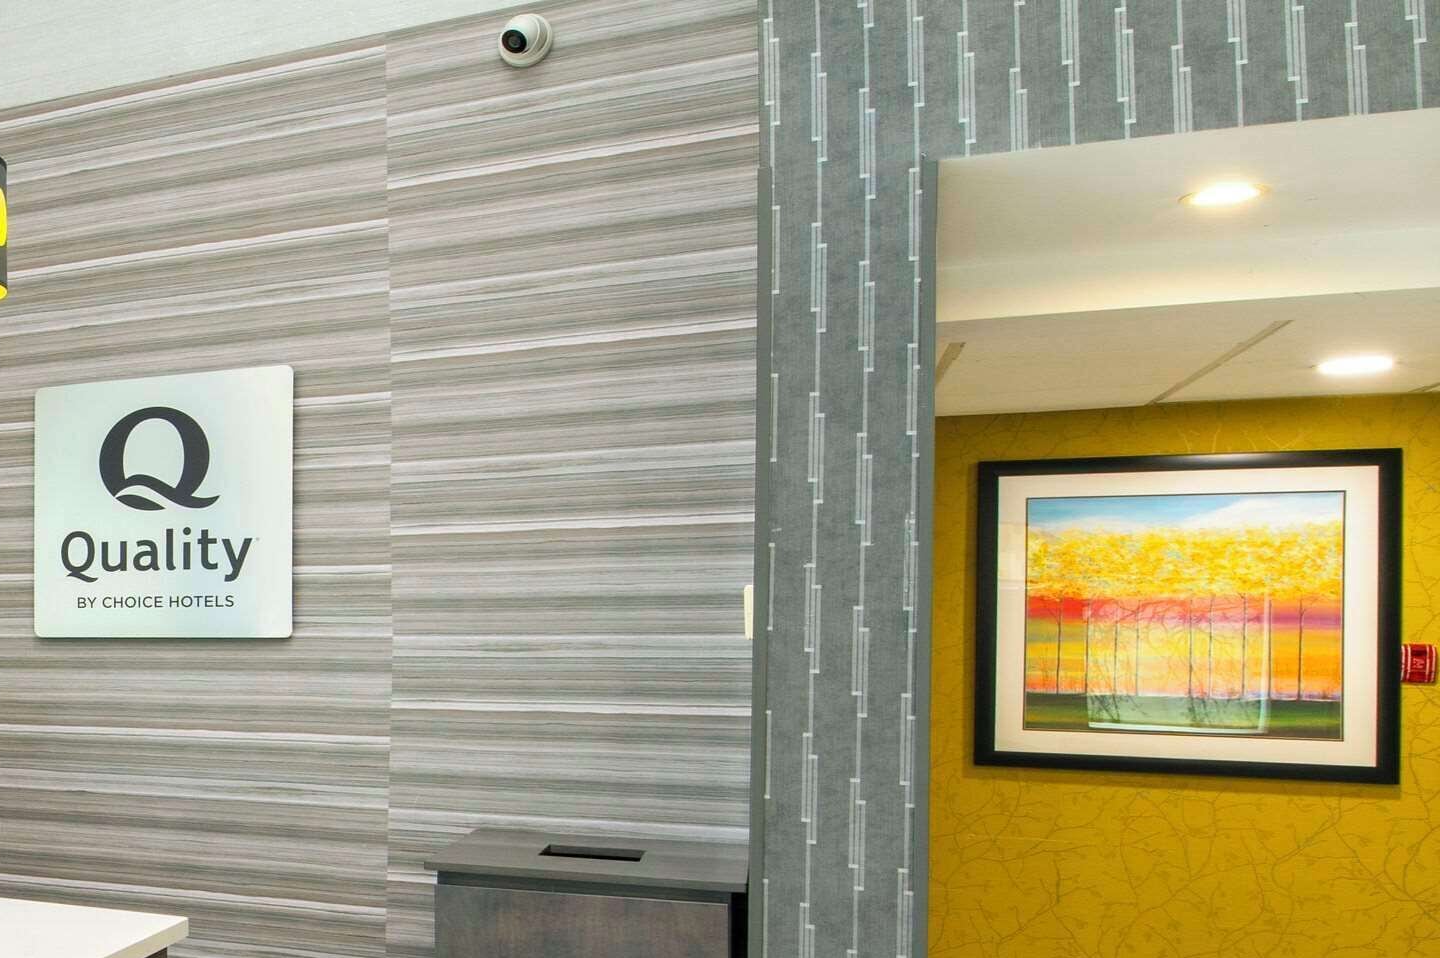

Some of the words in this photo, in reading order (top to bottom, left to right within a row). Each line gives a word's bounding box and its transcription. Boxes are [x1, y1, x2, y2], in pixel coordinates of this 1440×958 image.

[99, 406, 220, 511] Q
[60, 526, 253, 583] Quality
[77, 597, 97, 609] BY
[102, 595, 163, 609] CHOICE
[169, 595, 235, 608] HOTELS
